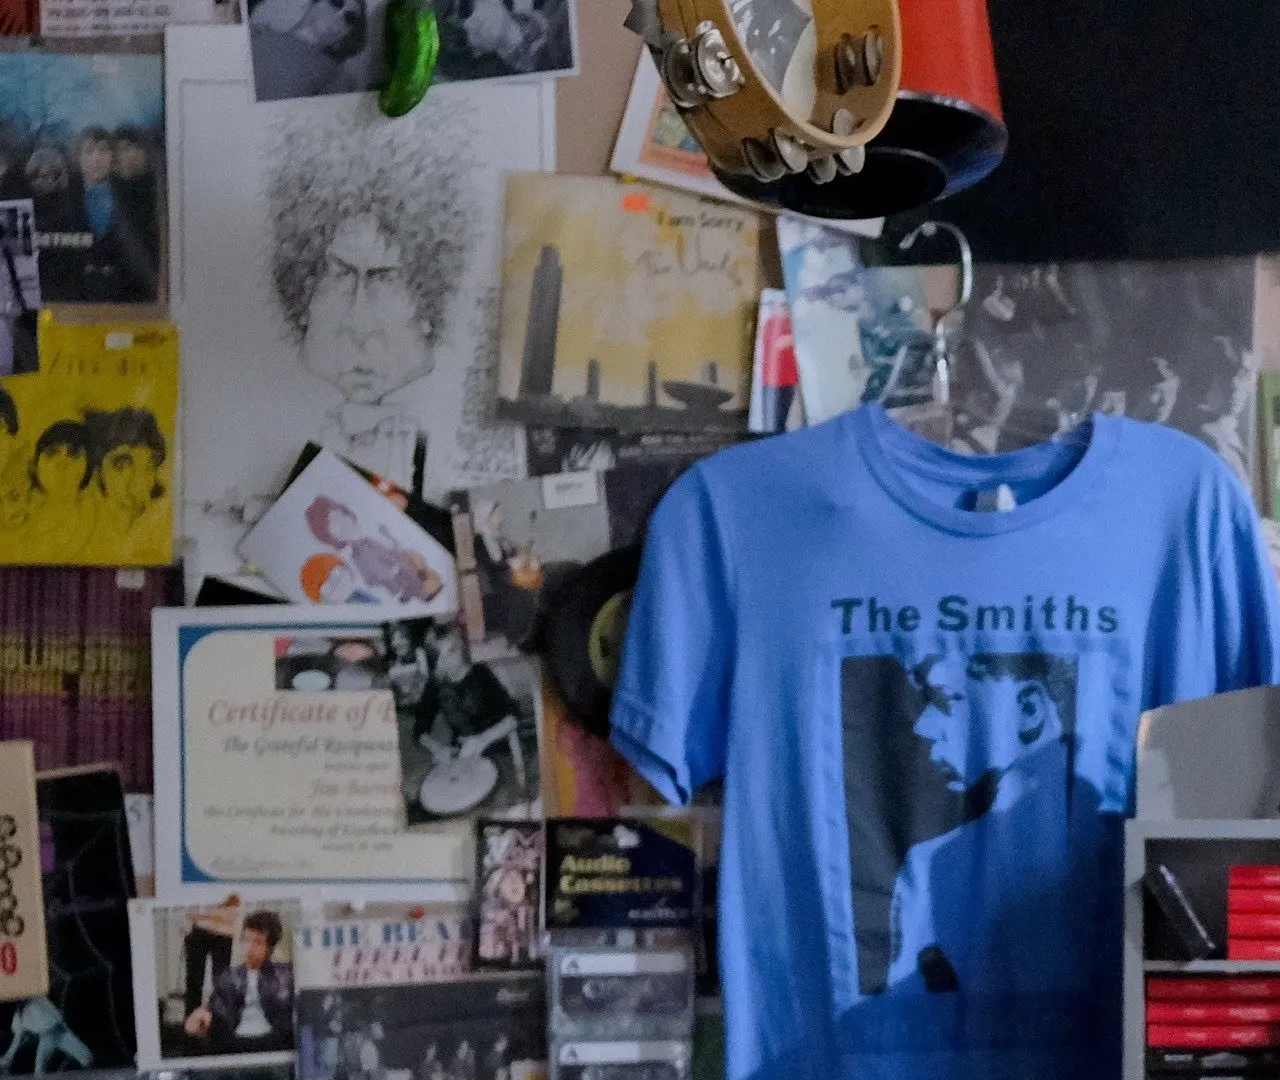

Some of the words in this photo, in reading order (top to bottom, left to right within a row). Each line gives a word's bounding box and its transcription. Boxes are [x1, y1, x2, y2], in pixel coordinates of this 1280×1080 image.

[831, 595, 921, 636] The
[937, 593, 1120, 635] Smiths
[206, 695, 338, 730] Certificate
[346, 693, 381, 729] of
